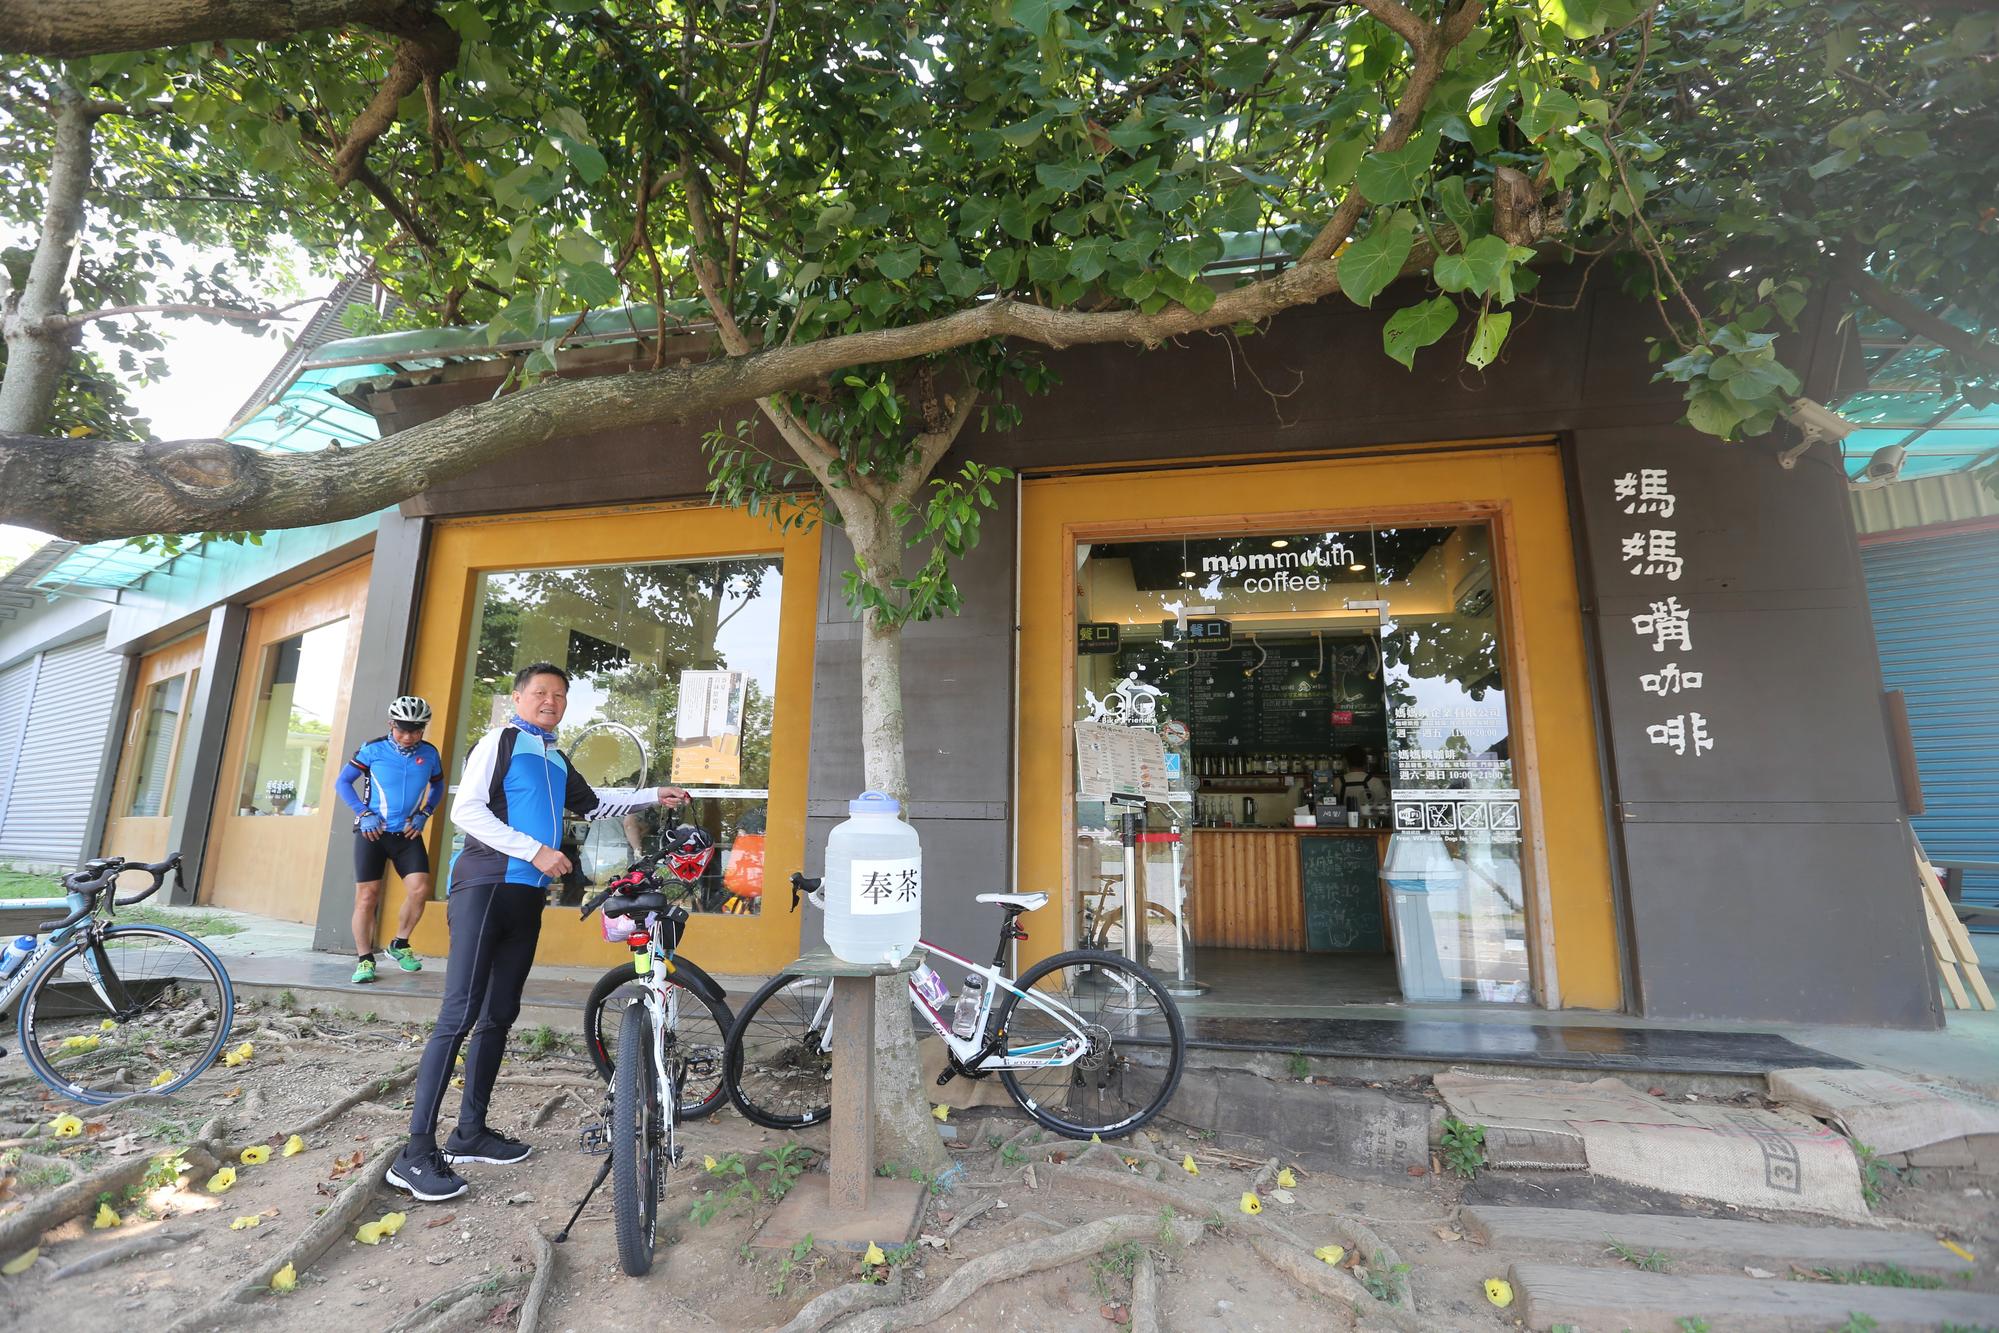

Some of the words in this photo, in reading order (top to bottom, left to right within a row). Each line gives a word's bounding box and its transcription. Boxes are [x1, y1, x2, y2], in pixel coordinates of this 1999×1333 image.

[1202, 545, 1355, 572] mommouth
[1244, 571, 1321, 593] coffee
[1614, 468, 1714, 757] 媽媽嘴咖啡
[861, 869, 918, 905] 奉茶
